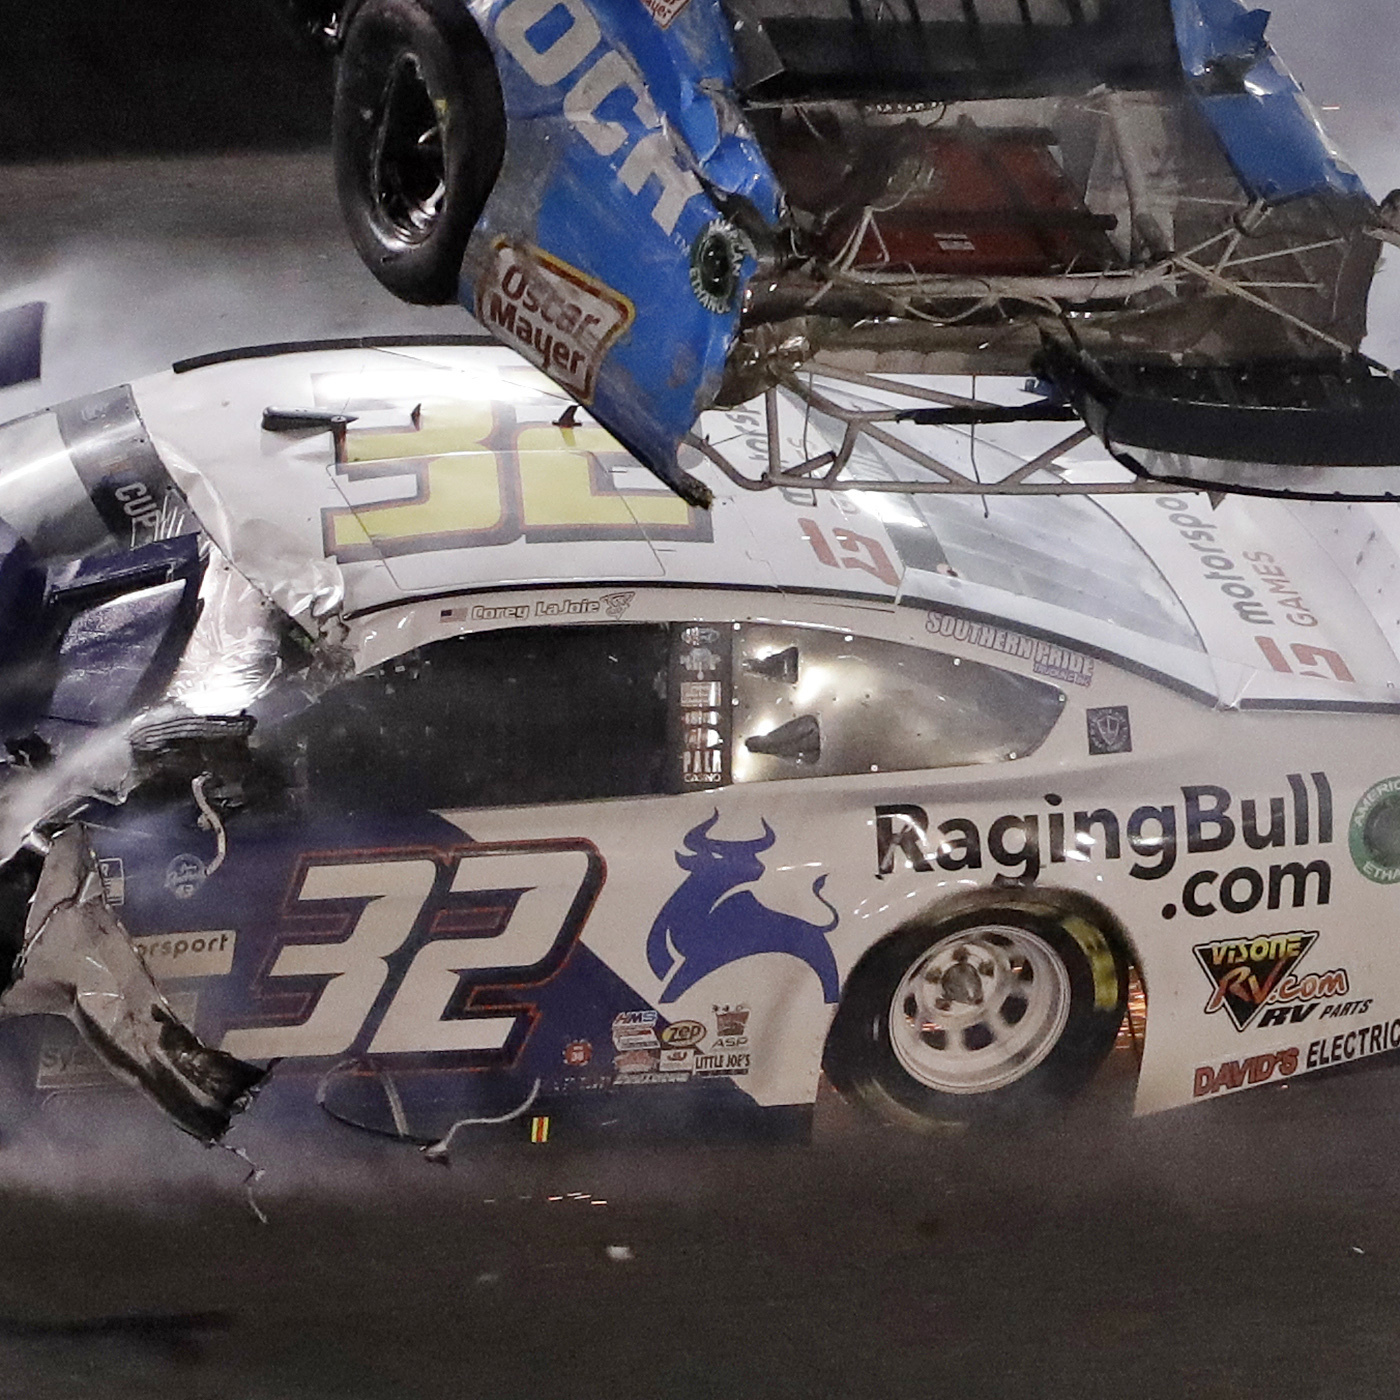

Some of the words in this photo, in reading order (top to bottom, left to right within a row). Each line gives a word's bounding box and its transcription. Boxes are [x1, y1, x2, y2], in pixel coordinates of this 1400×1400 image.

[501, 266, 600, 344] Oscar
[489, 291, 586, 383] Mayer
[115, 482, 162, 528] CUP
[1155, 495, 1276, 626] motorspo
[471, 605, 529, 621] Corey
[534, 599, 600, 617] LaJoie
[1243, 550, 1319, 627] GAMES
[926, 611, 1033, 660] SOUTHERN
[1033, 641, 1095, 676] PRIDE
[875, 771, 1333, 887] RagingBull
[1162, 858, 1332, 919] .com
[219, 843, 600, 1066] 32
[614, 1011, 657, 1025] HMS
[669, 1024, 701, 1042] zep
[1257, 1003, 1320, 1028] RV
[1320, 999, 1373, 1019] PARTS
[695, 1054, 725, 1069] LITTLE
[726, 1053, 751, 1068] JOE'S
[711, 1036, 749, 1048] ASP
[1193, 1047, 1300, 1097] DAVID'S
